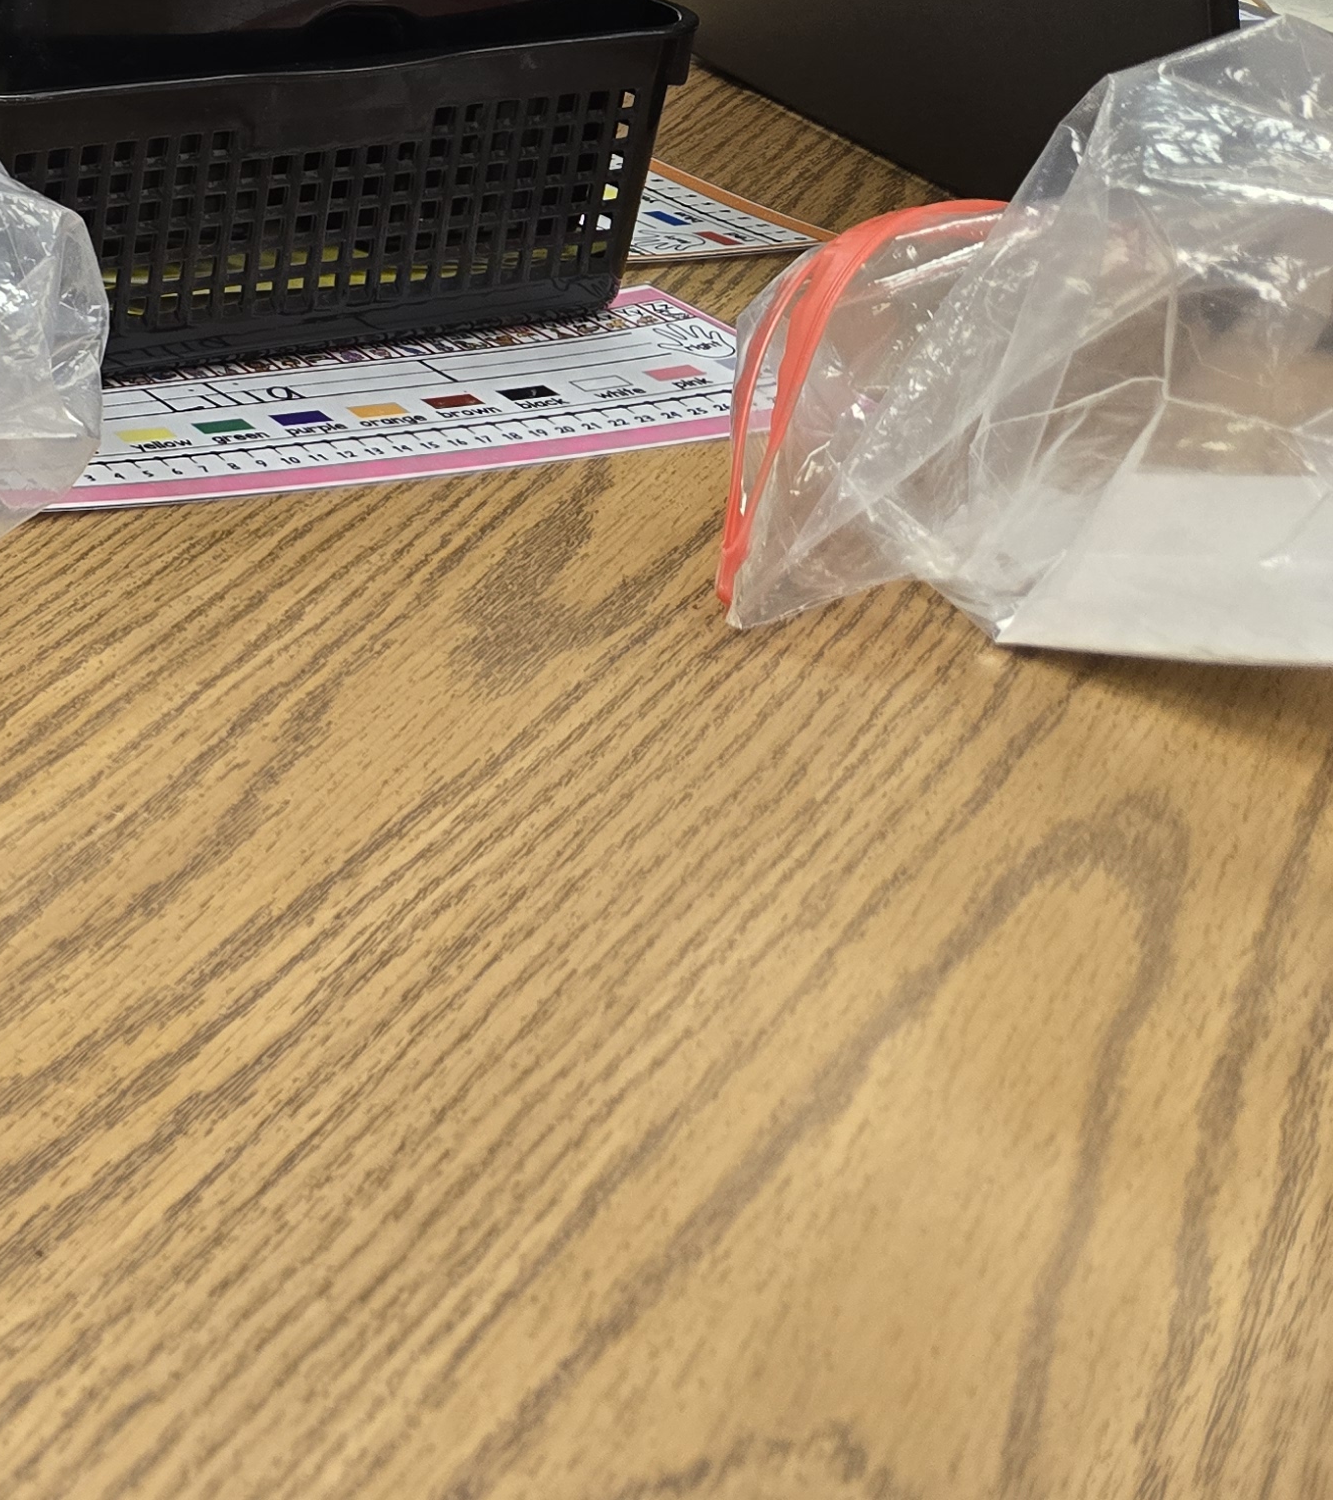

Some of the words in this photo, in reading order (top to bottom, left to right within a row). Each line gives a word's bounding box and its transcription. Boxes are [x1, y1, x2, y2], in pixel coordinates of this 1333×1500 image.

[649, 302, 675, 314] Zz
[683, 340, 722, 353] right
[130, 437, 193, 453] yellow
[212, 431, 271, 445] green
[286, 421, 349, 438] purple
[359, 413, 427, 428] orange
[436, 405, 502, 419] brown
[516, 396, 570, 411] black
[593, 386, 648, 400] white
[672, 376, 714, 391] pink
[84, 474, 96, 482] 3
[114, 472, 126, 481] 4
[143, 469, 154, 478] 5
[171, 467, 183, 476] 6
[199, 464, 209, 473] 7
[228, 461, 240, 470] 8
[256, 459, 267, 468] 9
[281, 456, 301, 466] 10
[309, 452, 329, 463] 11
[336, 449, 357, 460] 12
[364, 446, 385, 456] 13
[392, 444, 413, 453] 14
[420, 441, 440, 450] 15
[447, 438, 468, 447] 16
[474, 434, 493, 444] 17
[501, 432, 523, 441] 18
[528, 428, 549, 438] 19
[554, 425, 576, 435] 20
[581, 421, 602, 431] 21
[608, 418, 630, 427] 22
[634, 414, 656, 424] 23
[661, 410, 682, 420] 24
[687, 407, 709, 416] 25
